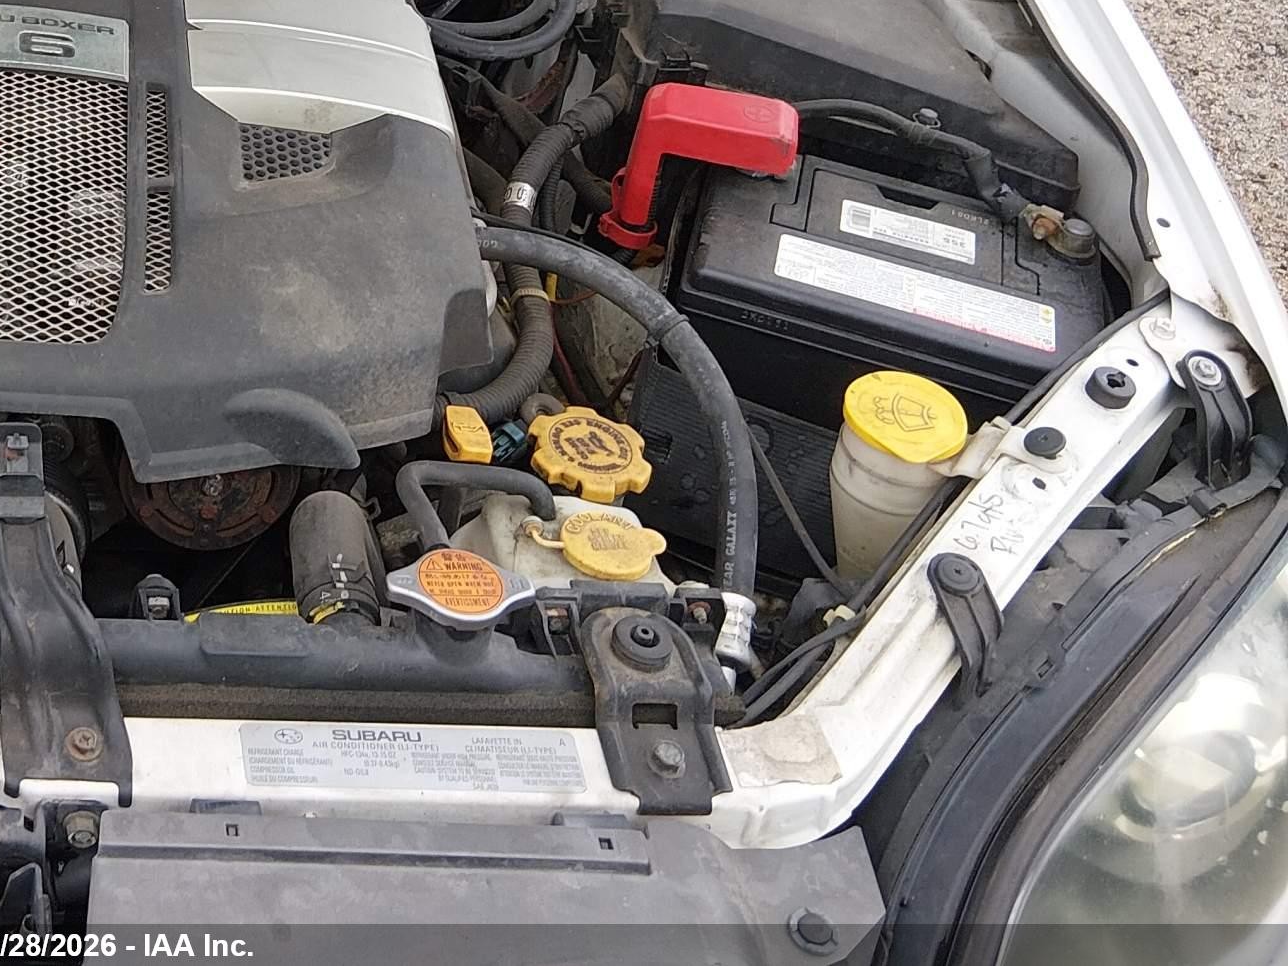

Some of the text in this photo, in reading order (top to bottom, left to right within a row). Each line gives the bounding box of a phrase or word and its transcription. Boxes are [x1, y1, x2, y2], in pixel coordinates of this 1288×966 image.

[21, 16, 115, 35] BOXER
[565, 512, 635, 534] COOLANT
[725, 510, 737, 556] GALAXY
[444, 561, 483, 571] WARNING
[332, 729, 421, 742] SUBARU
[331, 742, 396, 751] CONDITIONER
[559, 738, 566, 747] A
